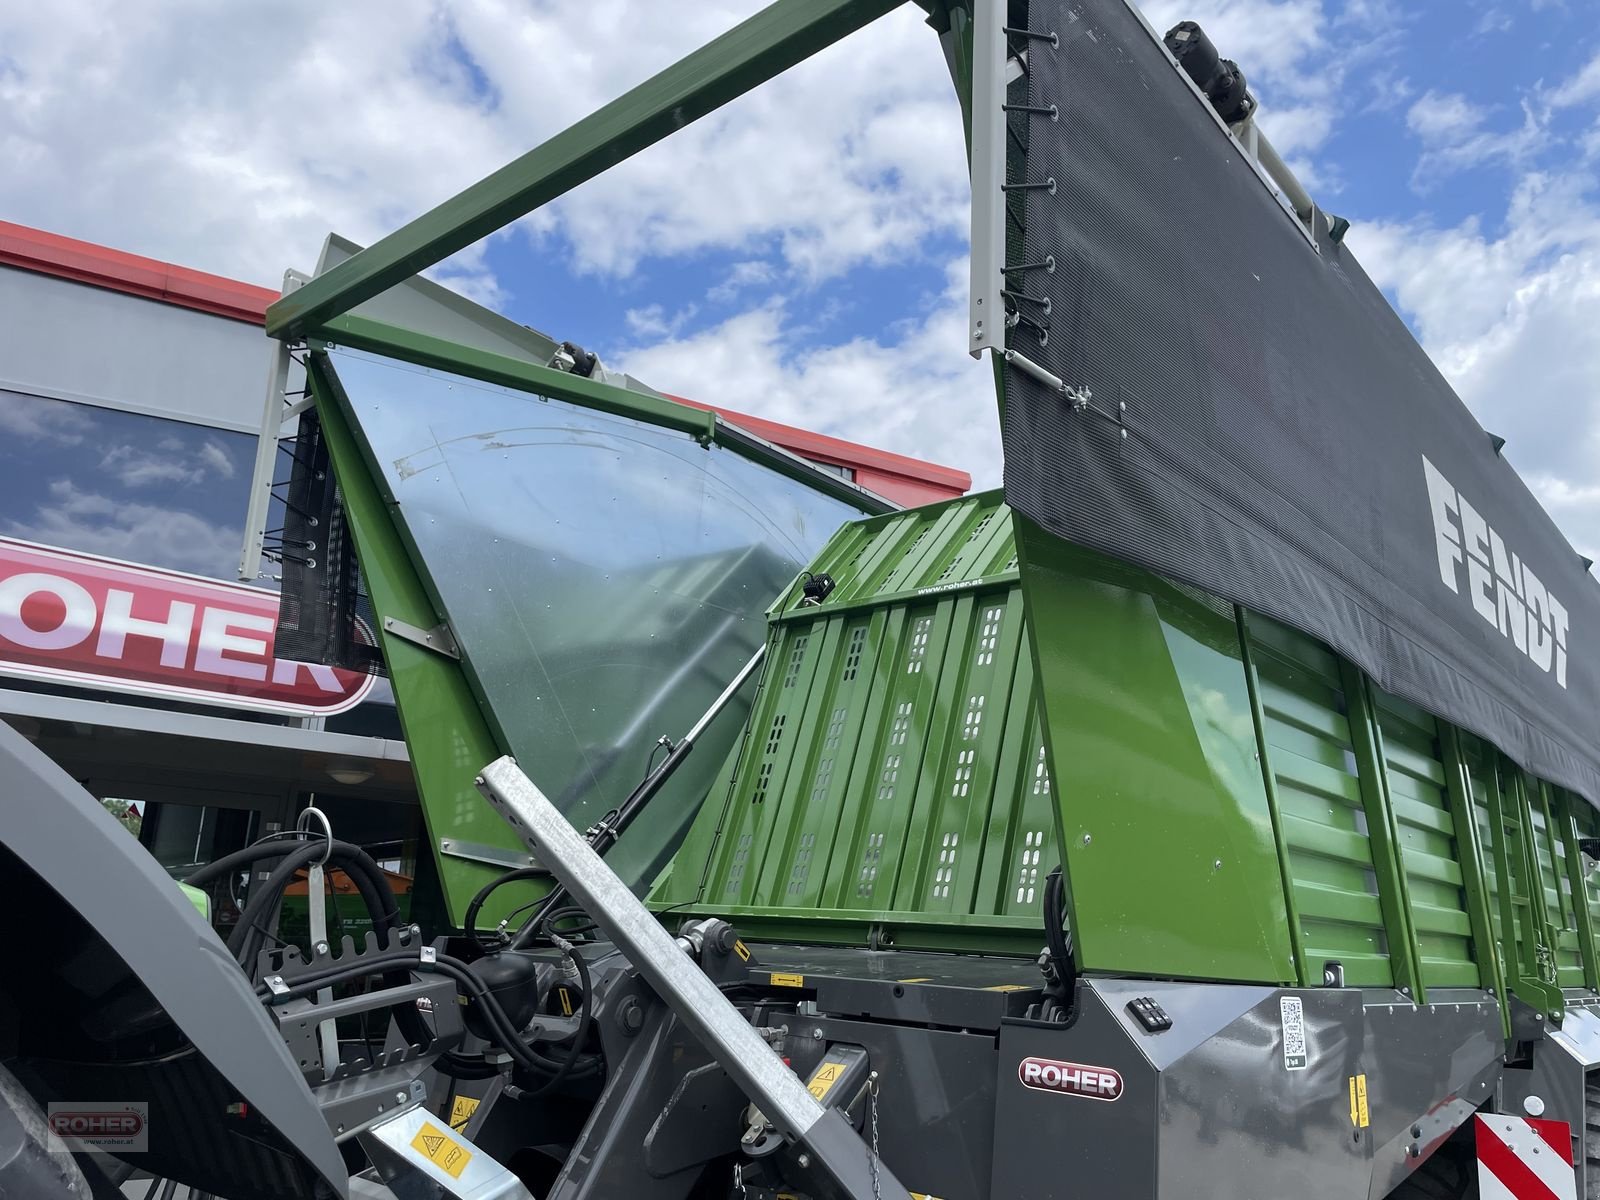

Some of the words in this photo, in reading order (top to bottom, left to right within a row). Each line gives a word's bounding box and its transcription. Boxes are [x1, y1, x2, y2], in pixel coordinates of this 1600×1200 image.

[917, 579, 983, 595] www.roher.at
[1422, 454, 1569, 689] FENDT
[1024, 1062, 1117, 1096] ROHER
